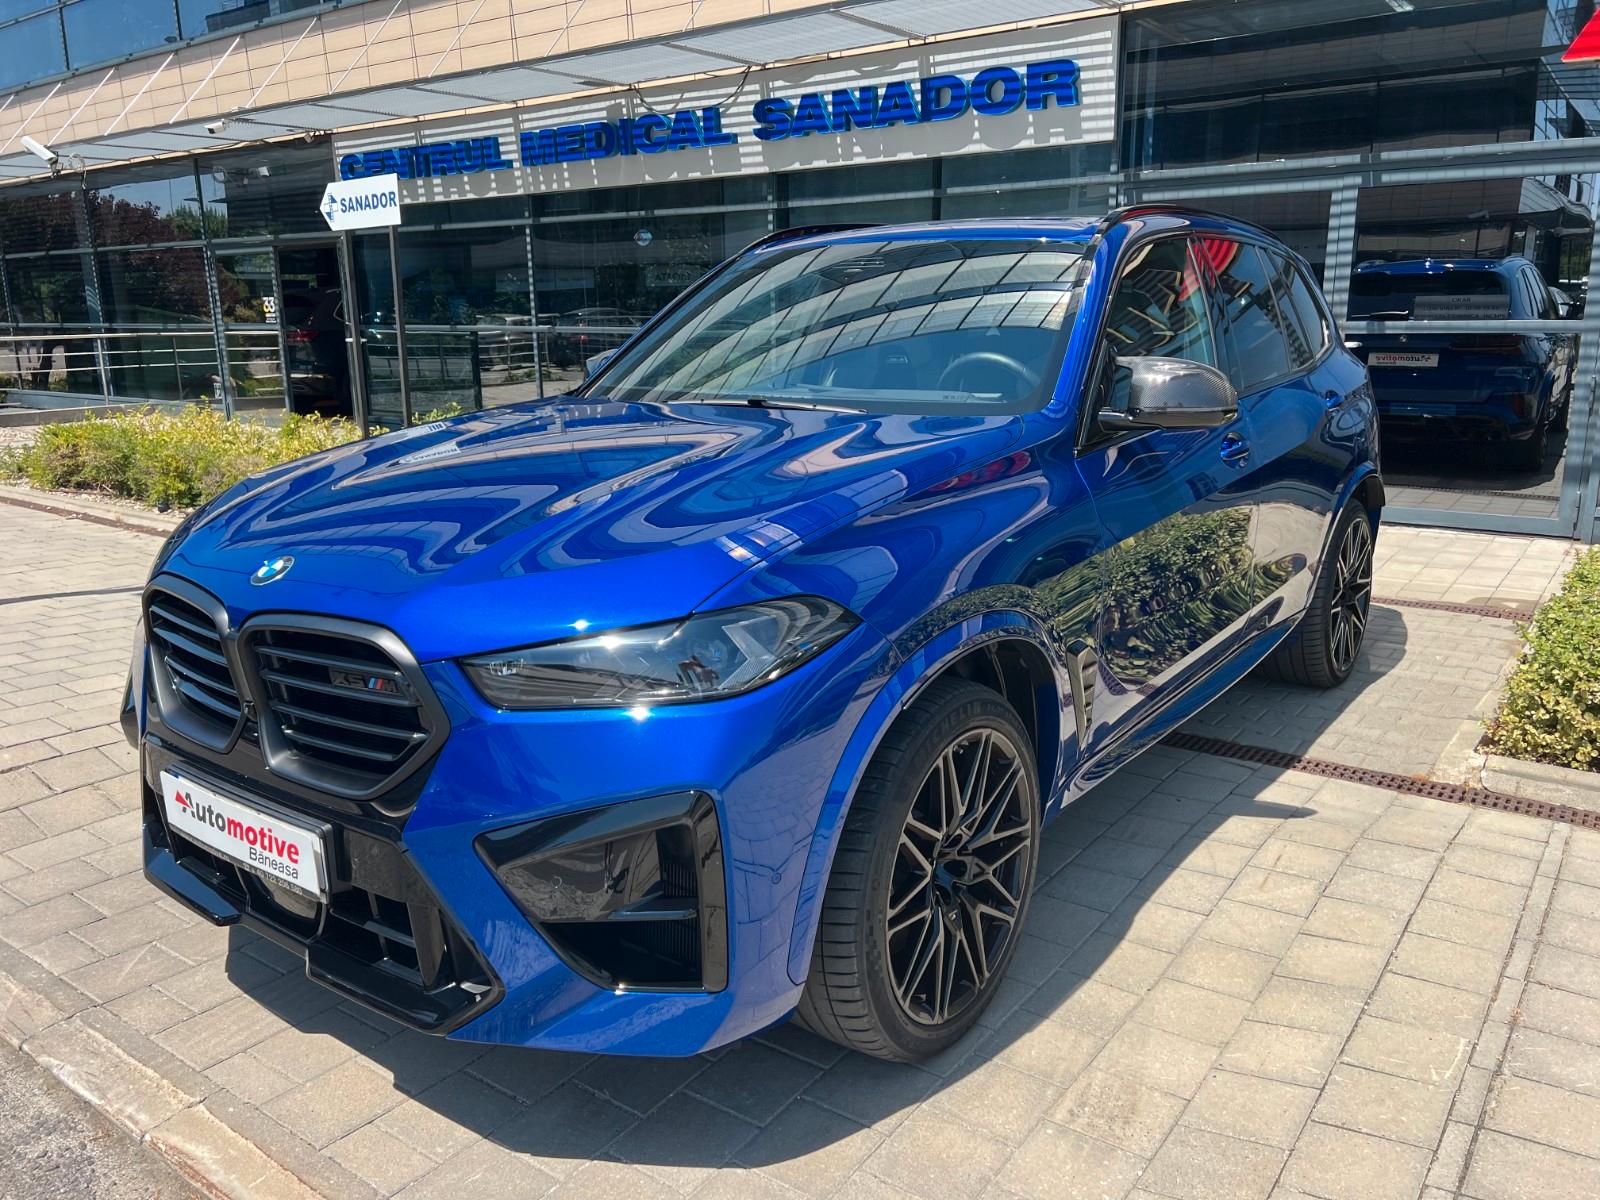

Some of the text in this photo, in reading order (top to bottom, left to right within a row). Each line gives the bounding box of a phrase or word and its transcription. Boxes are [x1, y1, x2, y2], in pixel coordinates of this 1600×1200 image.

[340, 58, 1080, 181] CENTRUL MEDICAL SANADOR
[340, 191, 397, 213] SANADOR
[175, 790, 299, 864] Automotive
[249, 847, 299, 879] Băneasa
